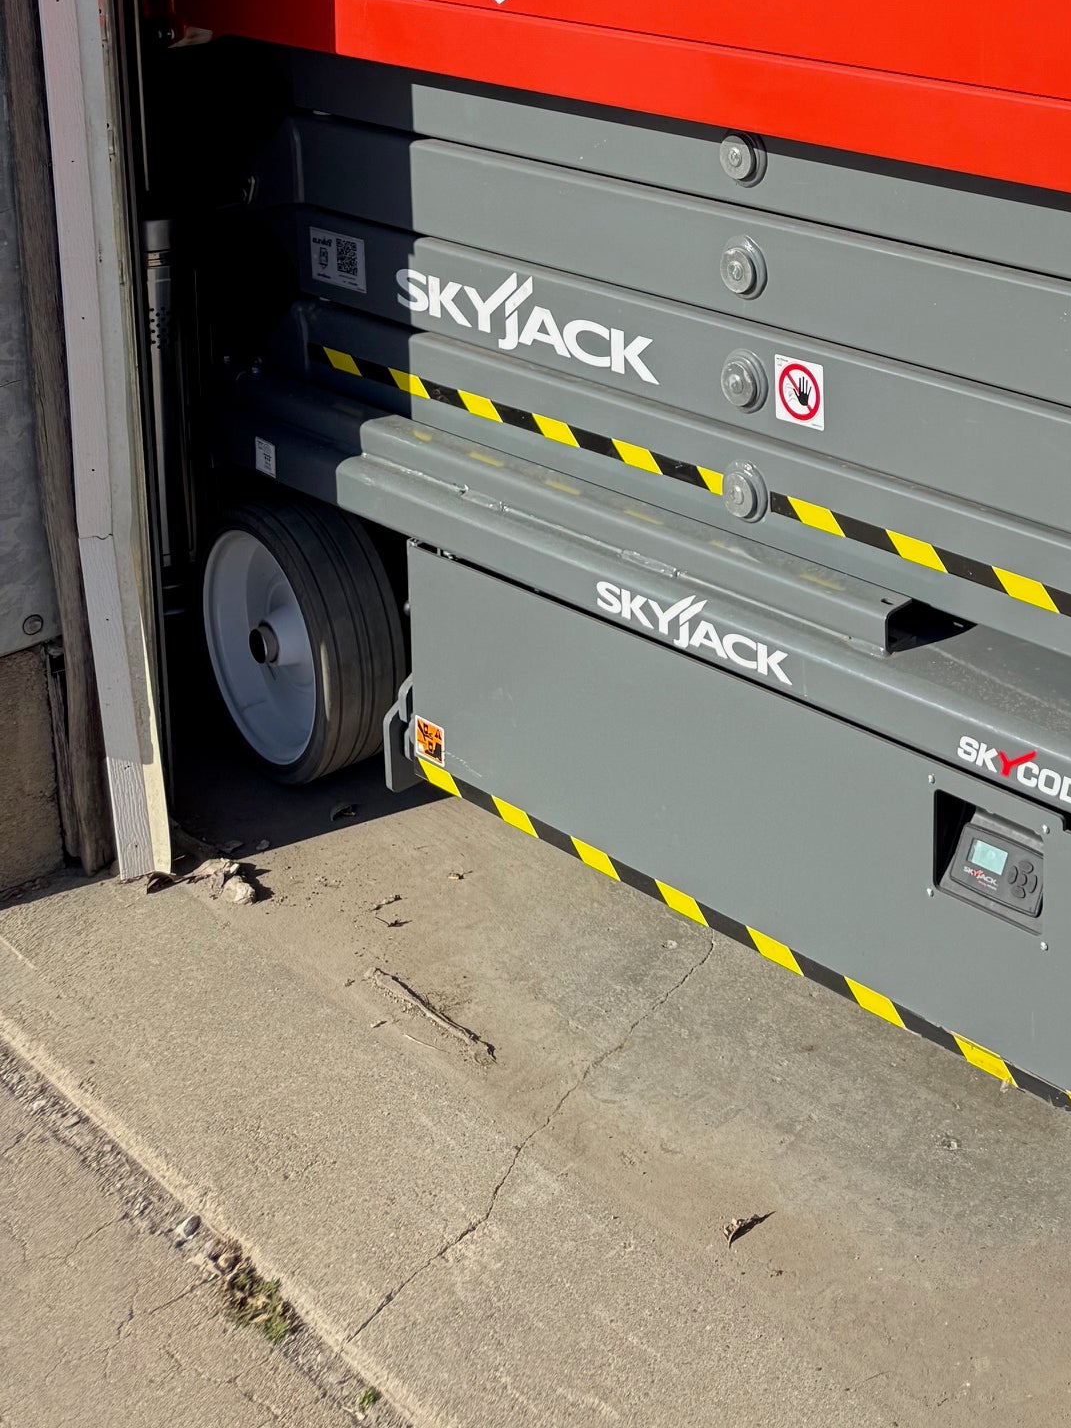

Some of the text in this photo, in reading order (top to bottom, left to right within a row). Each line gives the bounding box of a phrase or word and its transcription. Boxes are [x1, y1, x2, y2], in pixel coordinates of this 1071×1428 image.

[396, 268, 660, 385] SKYJACK
[596, 581, 793, 686] SKYJACK
[963, 866, 999, 887] SKYJACK
